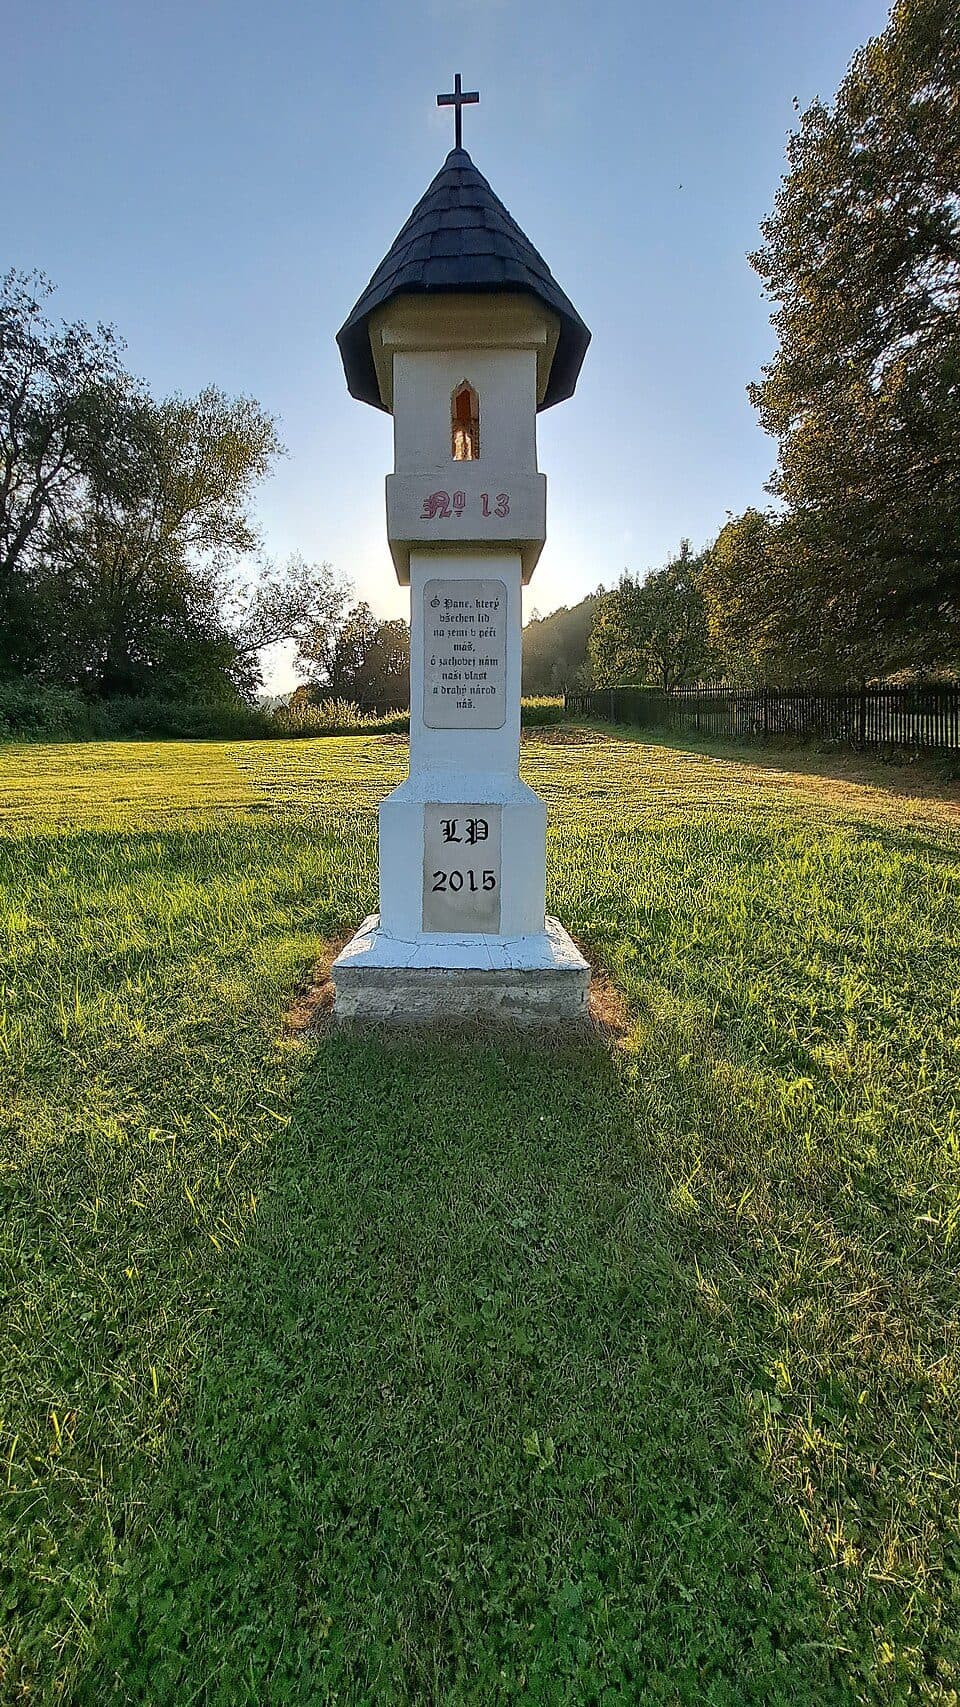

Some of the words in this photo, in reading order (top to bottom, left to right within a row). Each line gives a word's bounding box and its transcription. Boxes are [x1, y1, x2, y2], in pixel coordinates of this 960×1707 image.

[480, 494, 510, 517] 13
[475, 596, 499, 610] který
[439, 613, 474, 623] všechen
[478, 614, 489, 622] lid
[447, 629, 467, 638] zemi
[470, 629, 476, 637] v
[479, 627, 496, 638] péči
[439, 657, 475, 667] zachovej
[479, 656, 498, 666] nám
[442, 670, 461, 680] naši
[464, 671, 487, 680] vlast
[441, 684, 467, 696] drahý
[470, 684, 496, 694] národ
[440, 819, 488, 845] LP
[432, 870, 495, 891] 2015
